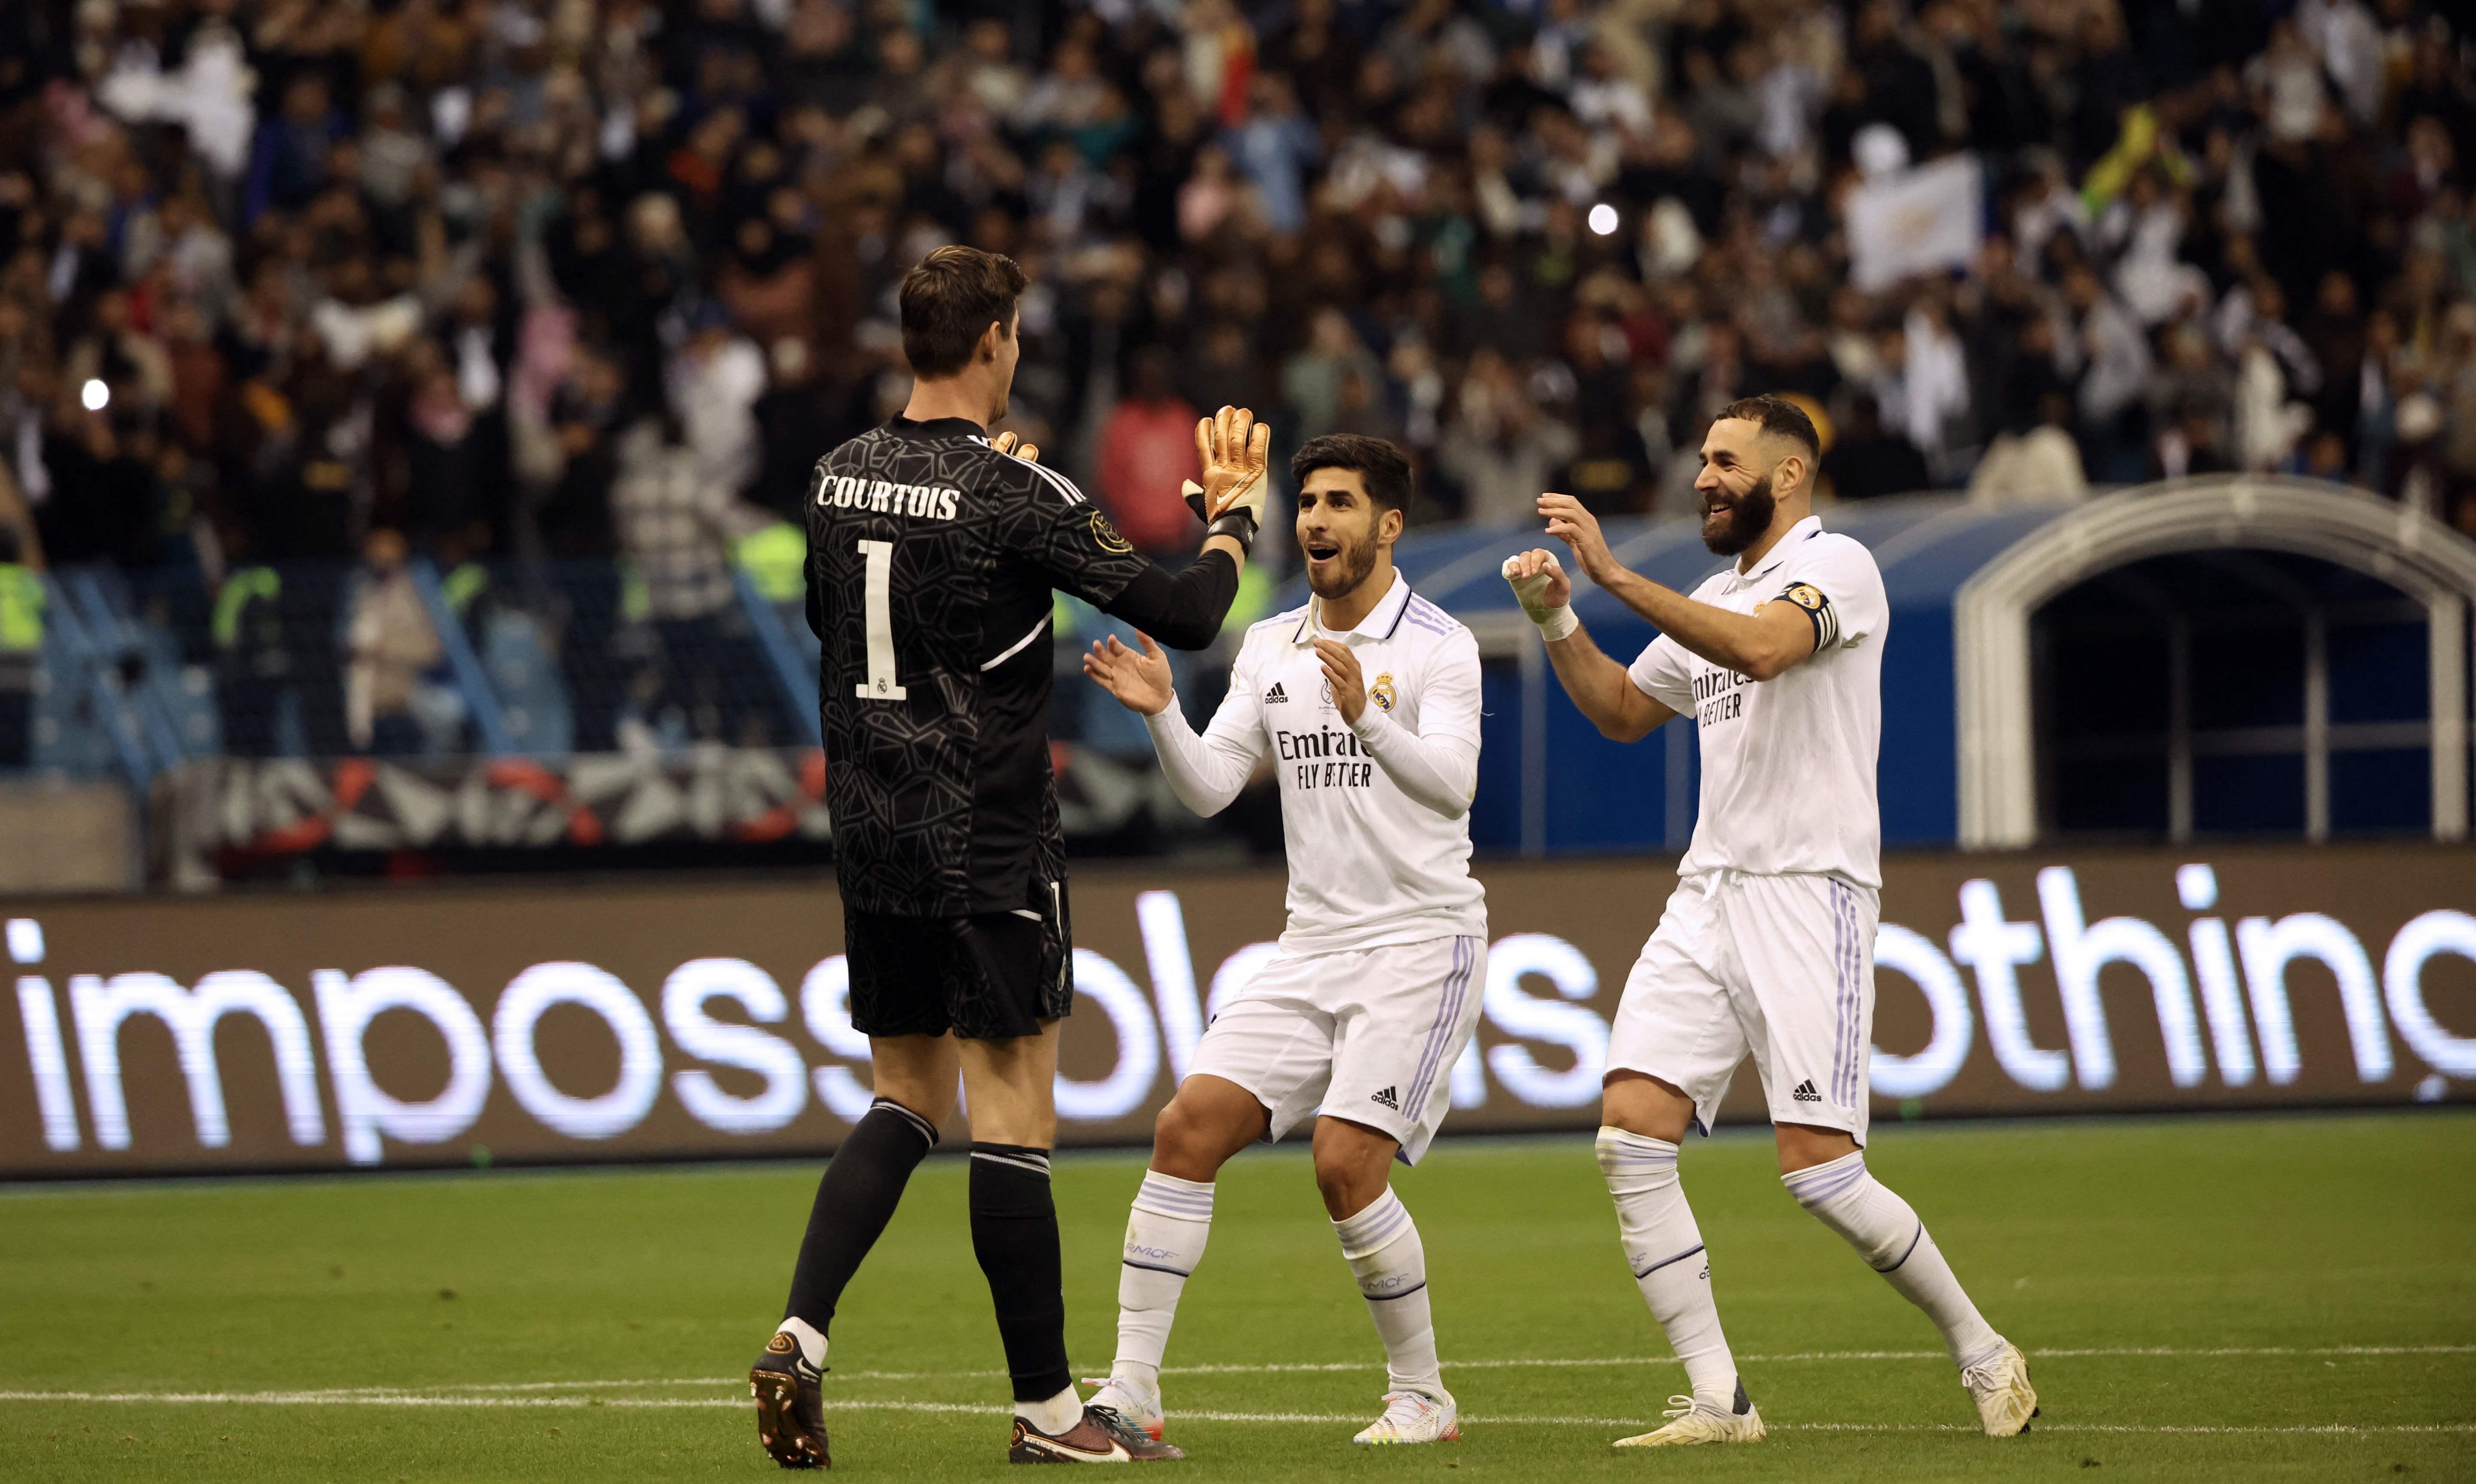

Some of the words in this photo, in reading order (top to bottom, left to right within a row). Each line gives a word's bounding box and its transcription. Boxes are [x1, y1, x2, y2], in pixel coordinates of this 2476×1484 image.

[817, 475, 960, 521] COURTOIS
[856, 539, 906, 700] 1
[1265, 695, 1288, 704] adidas
[1691, 667, 1754, 702] mirate
[1703, 693, 1741, 728] BETTER
[1276, 725, 1372, 760] Emiat
[1298, 764, 1319, 789] FLY
[1325, 762, 1371, 787] BETTER
[1867, 863, 2476, 1103] othin
[1371, 1094, 1398, 1111] adidas
[1793, 1093, 1822, 1102] adidas
[1125, 1243, 1179, 1259] RMCF
